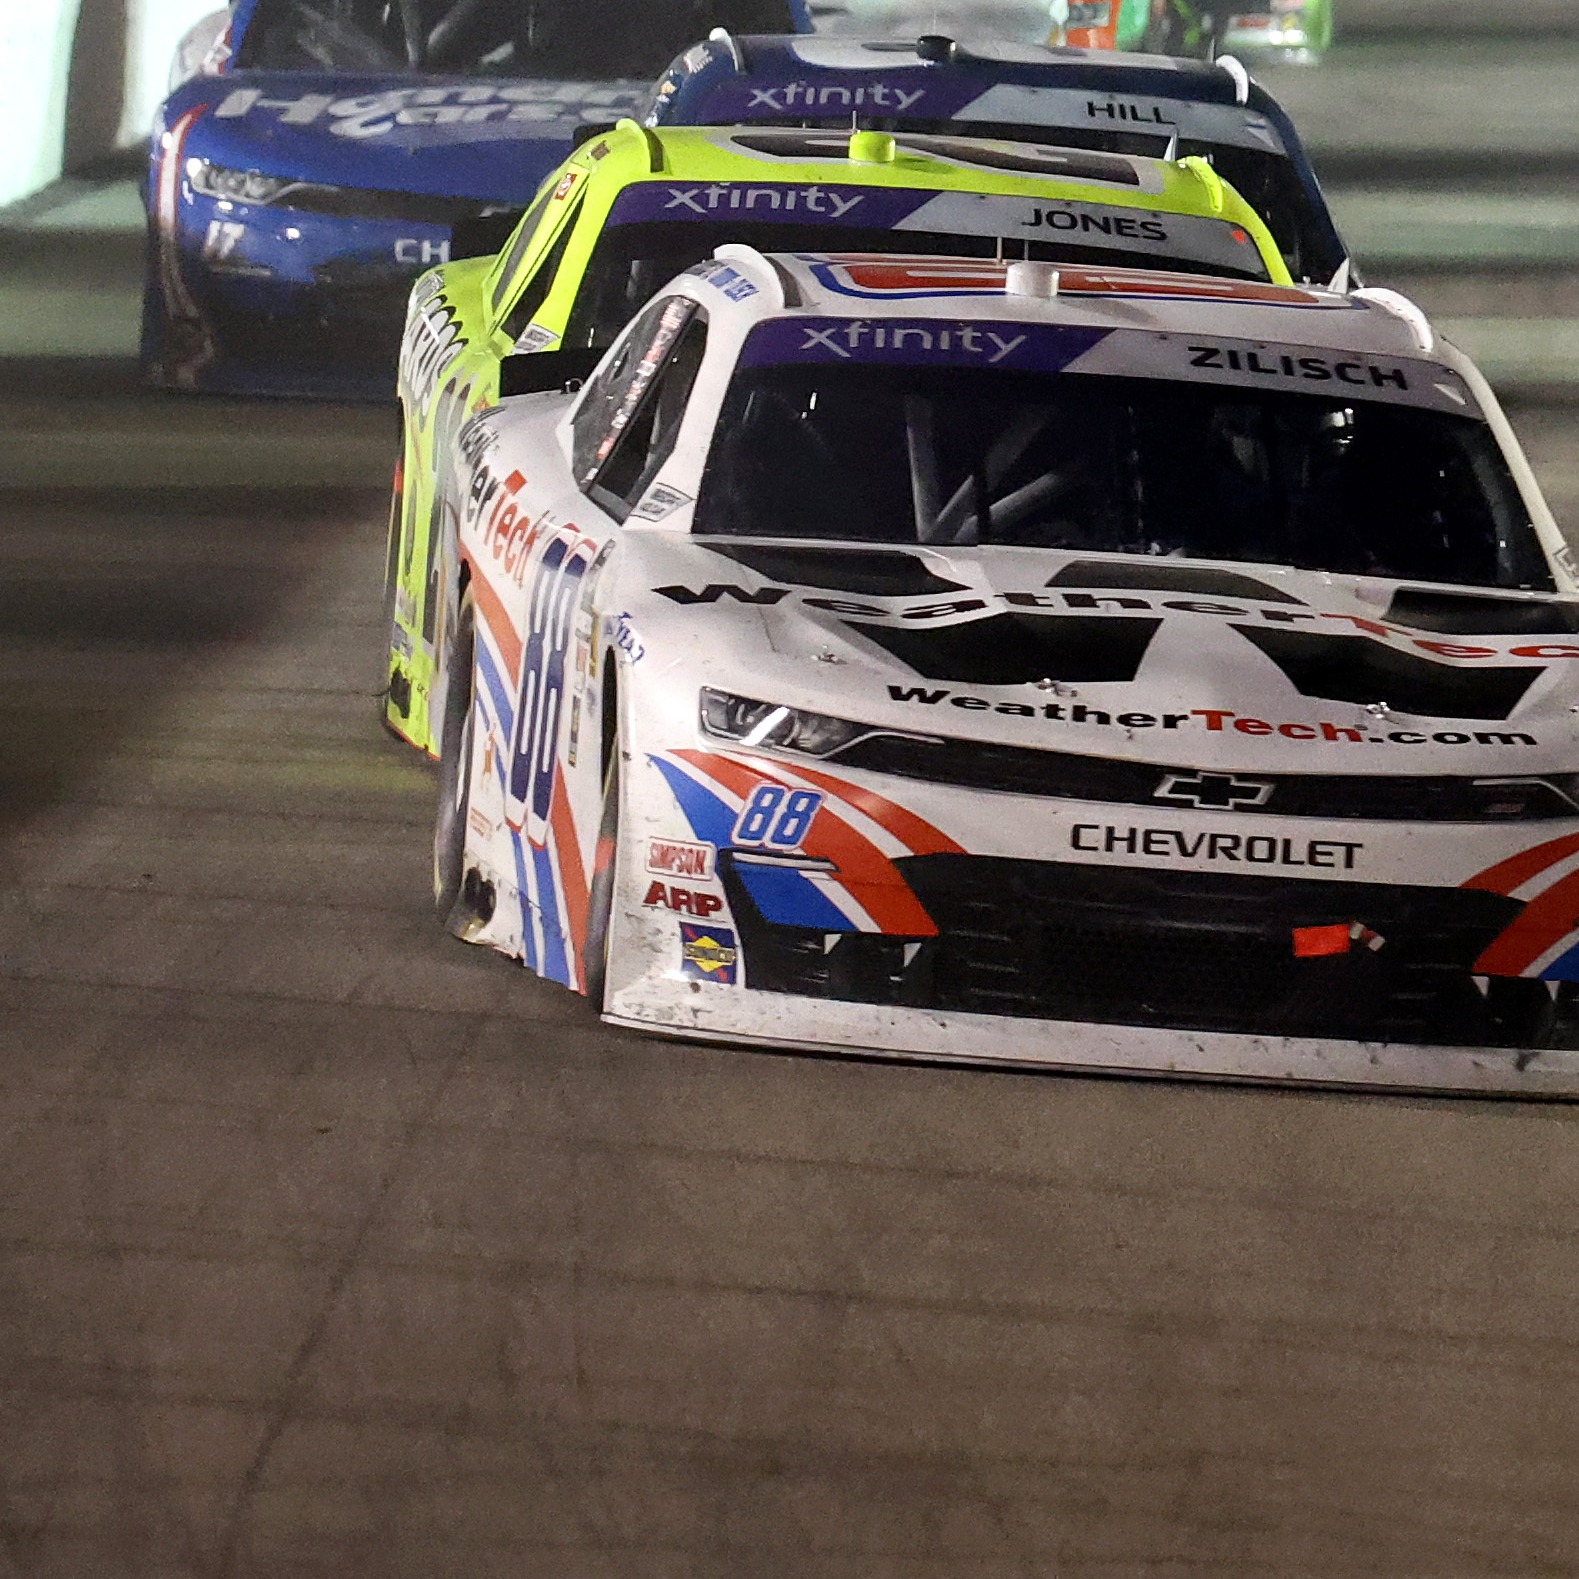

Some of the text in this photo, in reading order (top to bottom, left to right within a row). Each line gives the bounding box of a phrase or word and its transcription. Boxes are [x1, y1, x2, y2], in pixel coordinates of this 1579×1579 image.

[748, 79, 926, 110] xfinity
[1086, 99, 1170, 124] HILL
[664, 182, 864, 219] xfinity
[1023, 207, 1168, 242] JONES
[800, 322, 1028, 363] xfinity
[1186, 346, 1409, 391] ZILISCH
[888, 685, 1538, 748] WeatherTech.com
[733, 782, 824, 849] 88
[1071, 824, 1363, 869] CHEVROLET
[643, 880, 723, 917] ARP
